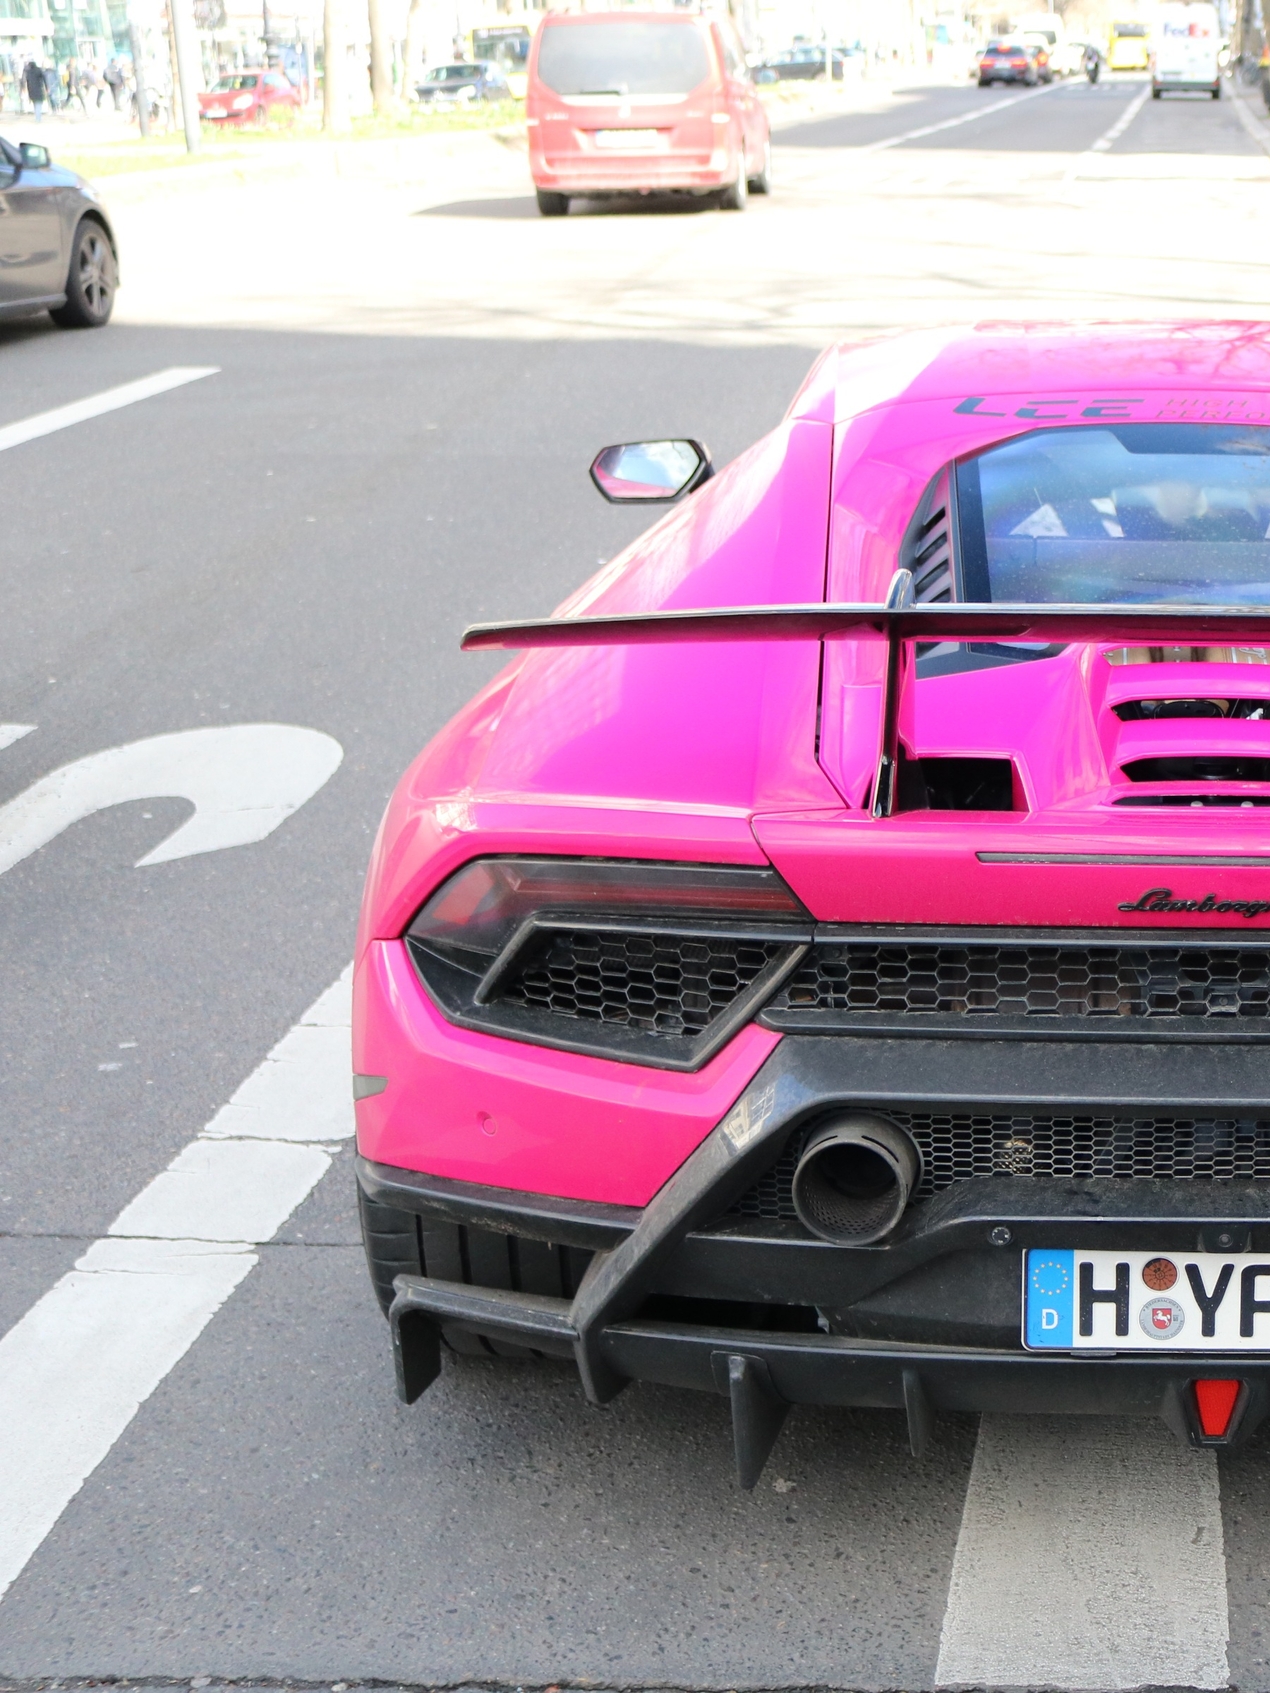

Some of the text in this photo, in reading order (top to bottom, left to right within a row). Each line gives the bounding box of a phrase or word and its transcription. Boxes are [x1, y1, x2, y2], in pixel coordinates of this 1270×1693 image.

[1165, 399, 1249, 408] HIGH
[1079, 1261, 1130, 1337] H
[1041, 1308, 1058, 1330] D
